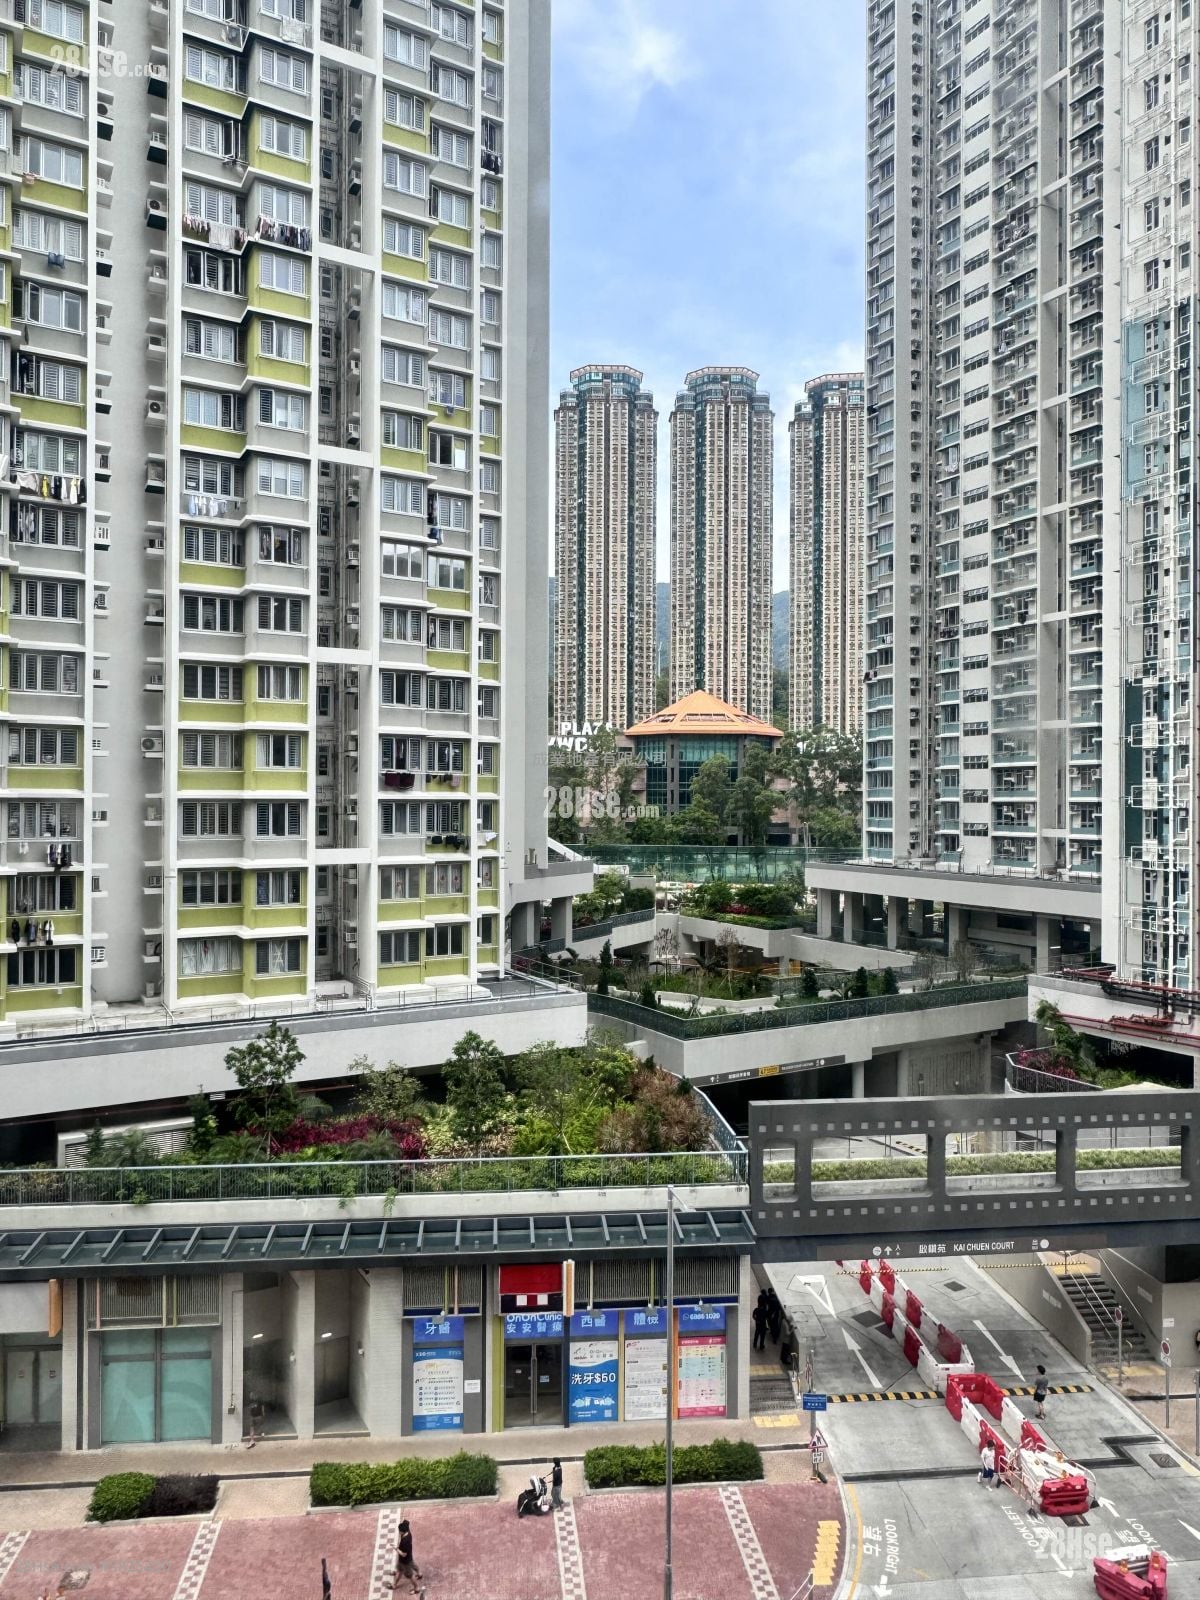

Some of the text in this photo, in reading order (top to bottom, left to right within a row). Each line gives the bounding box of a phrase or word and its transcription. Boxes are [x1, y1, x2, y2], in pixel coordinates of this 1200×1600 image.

[953, 1243, 966, 1252] KAI
[966, 1242, 990, 1252] CHUEN
[991, 1241, 1015, 1250] COURT
[1125, 1518, 1158, 1544] LOOK
[883, 1518, 900, 1575] LOOK RIGHT
